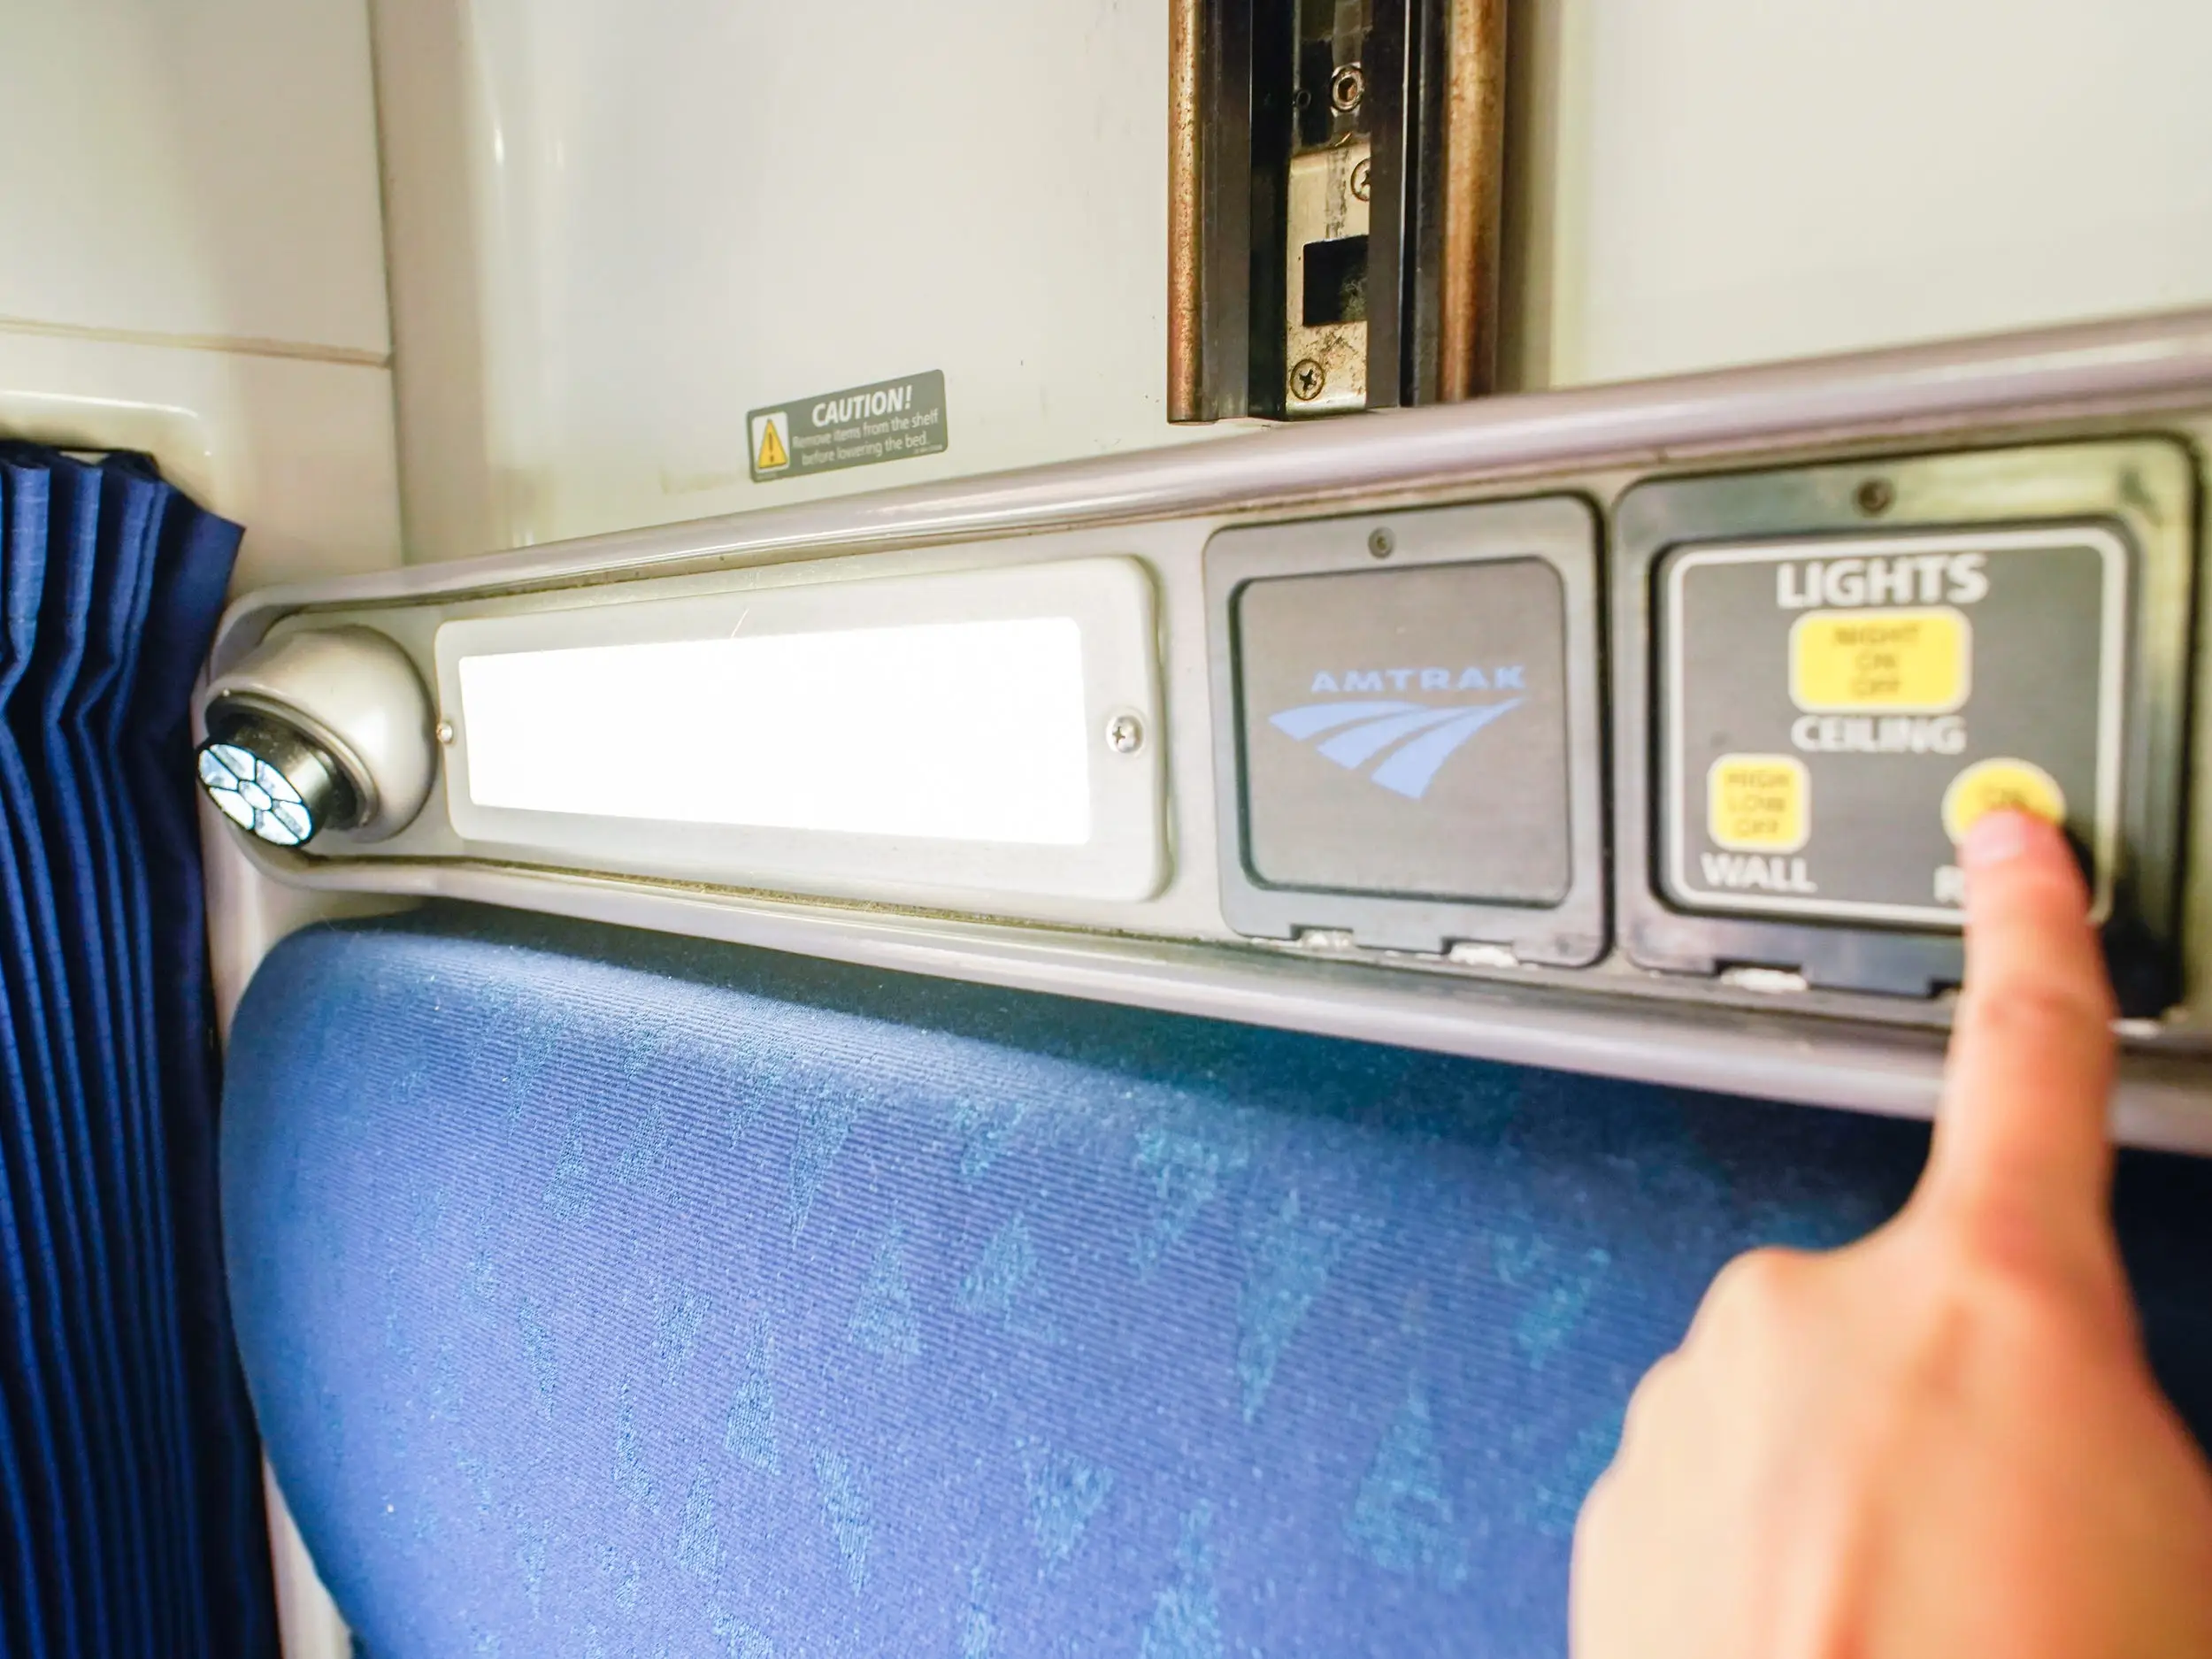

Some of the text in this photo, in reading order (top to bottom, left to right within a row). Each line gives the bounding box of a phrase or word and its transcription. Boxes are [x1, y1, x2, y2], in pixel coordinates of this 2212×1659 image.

[812, 385, 912, 427] CAUTION!
[833, 426, 861, 442] items
[863, 419, 890, 436] from
[891, 414, 910, 431] the
[911, 408, 940, 428] shelf
[802, 448, 834, 466] before
[837, 442, 883, 461] lowering
[884, 436, 902, 452] the
[1777, 552, 1989, 609] LIGHTS
[1310, 665, 1525, 692] AMTRAK
[1791, 715, 1968, 755] CEILING
[1701, 852, 1817, 894] WALL
